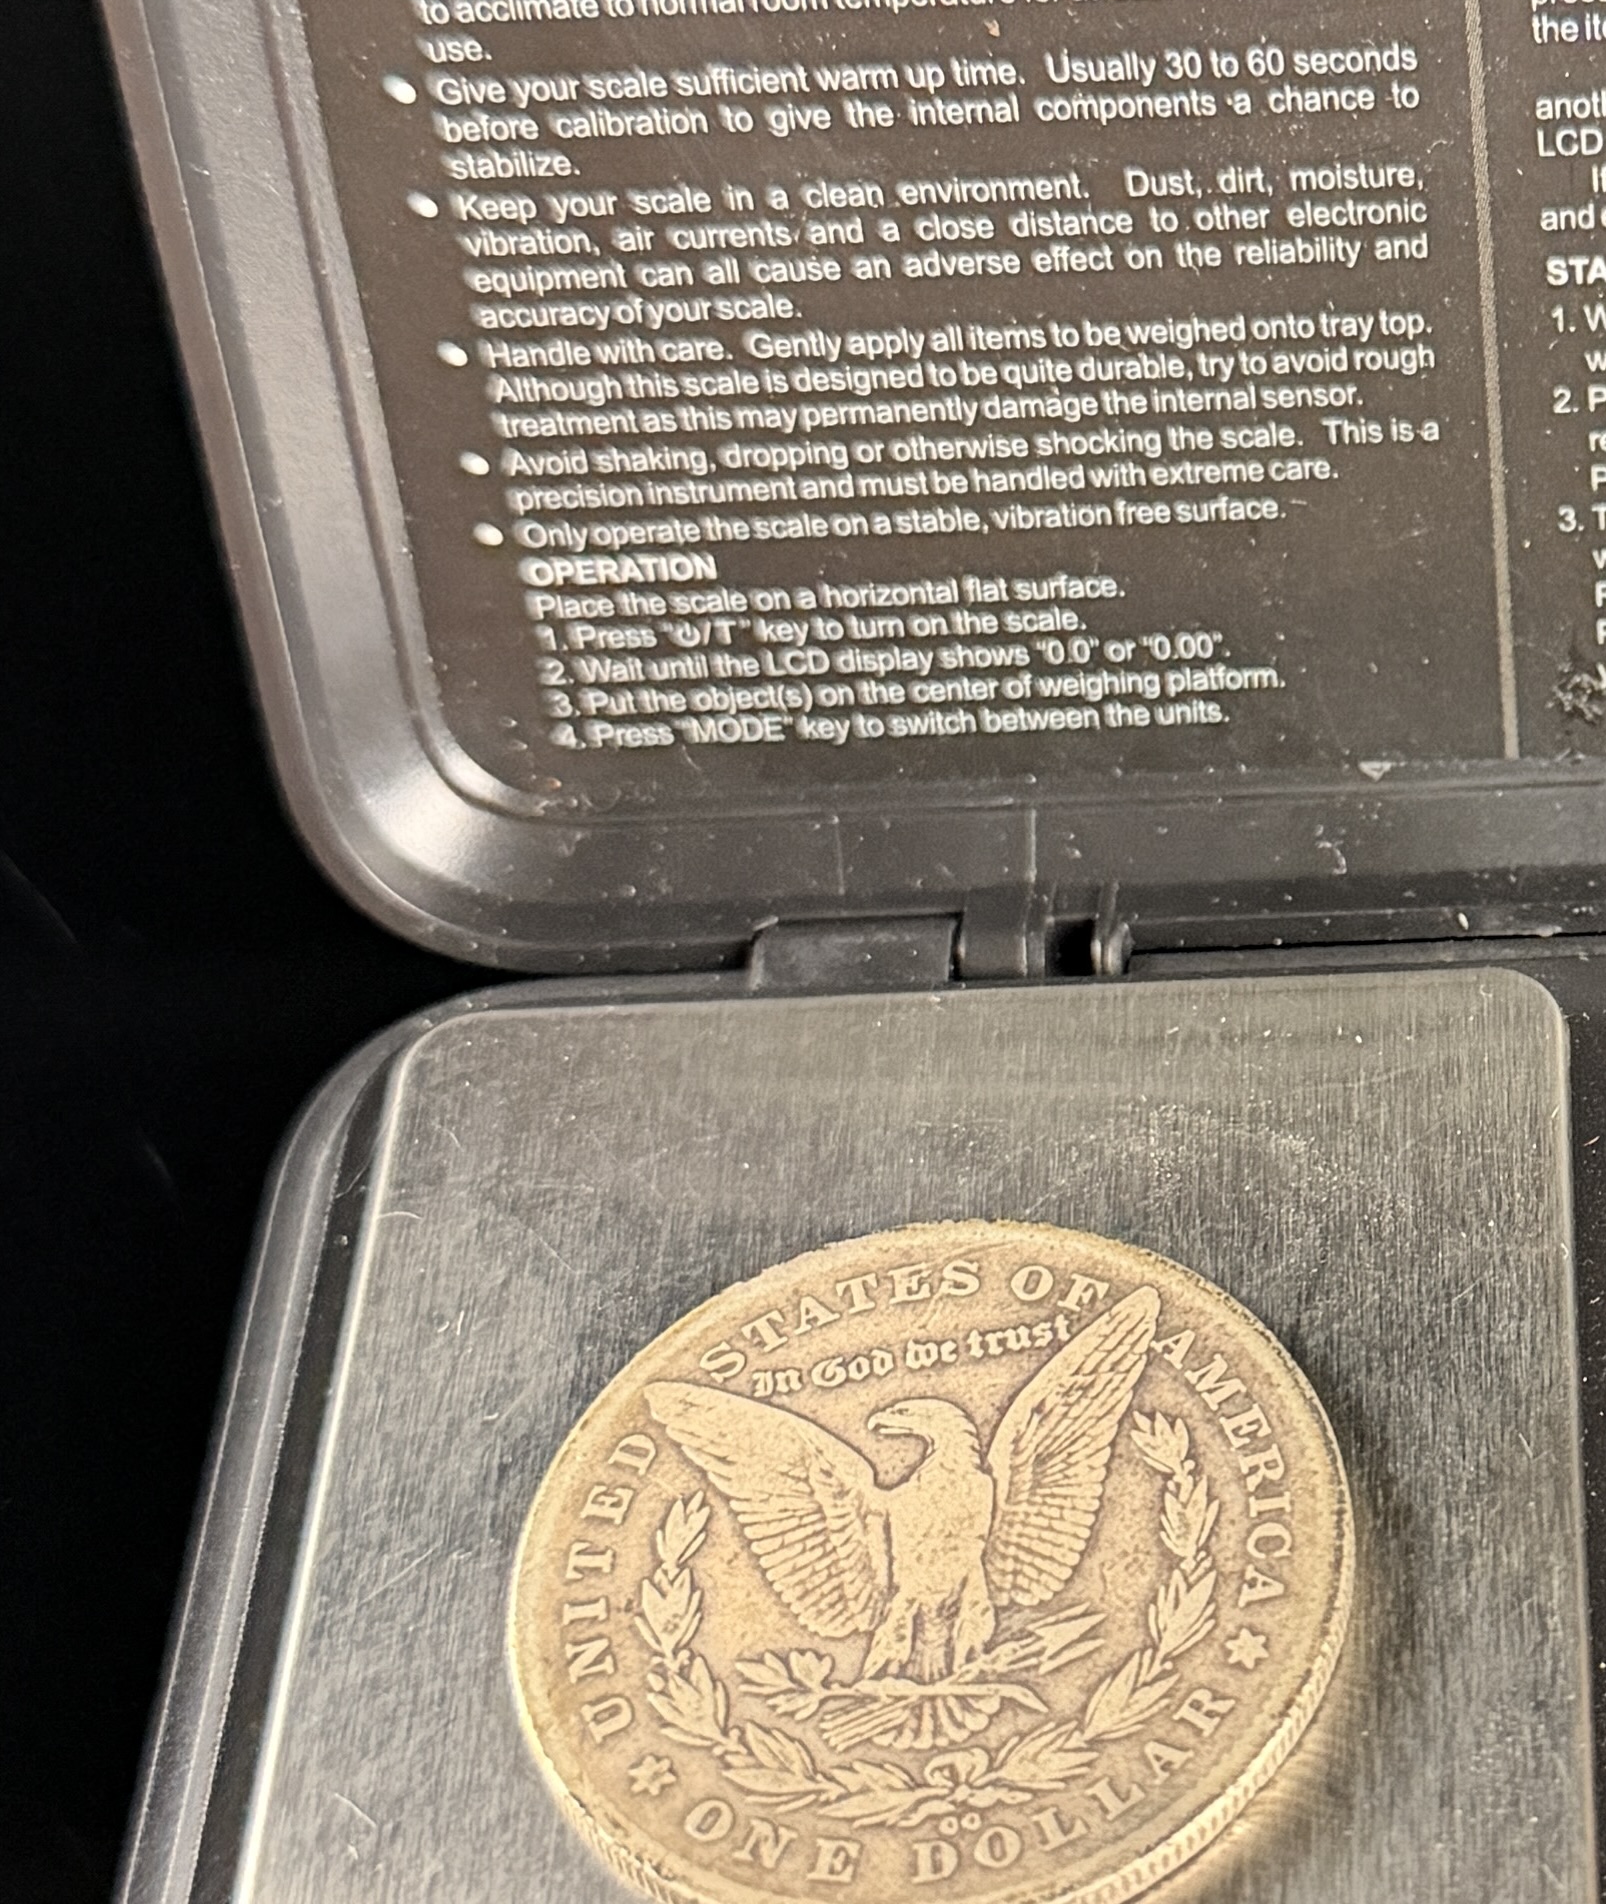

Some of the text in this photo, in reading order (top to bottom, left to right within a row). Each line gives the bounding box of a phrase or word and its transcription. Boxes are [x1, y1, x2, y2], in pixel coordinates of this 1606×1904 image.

[428, 41, 1418, 108] Give your scale sufficient warm up time. Usually 30 to 60 seconds
[443, 146, 580, 179] stabilize.
[450, 189, 538, 226] Keep
[546, 193, 619, 223] your
[628, 183, 711, 214] scale
[722, 182, 754, 211] in
[765, 187, 789, 209] a
[800, 177, 884, 208] clean
[895, 170, 1089, 205] environment.
[1289, 159, 1424, 194] moisture,
[1540, 202, 1594, 231] and
[1553, 386, 1578, 413] 2.
[521, 552, 717, 585] OPERATION
[527, 570, 1125, 619] Place the scale on a horizontal flat surface.
[555, 724, 585, 750] 4.
[594, 720, 675, 749] Press
[797, 713, 851, 745] key
[852, 711, 885, 737] to
[888, 707, 977, 736] switch
[980, 702, 1100, 732] between
[1104, 700, 1151, 727] the
[1154, 697, 1230, 725] units.
[752, 1314, 1072, 1397] In God we trust
[565, 1259, 1294, 1744] UNITED STATES OF AMERICA
[685, 1685, 1237, 1884] ONE DOLLAR
